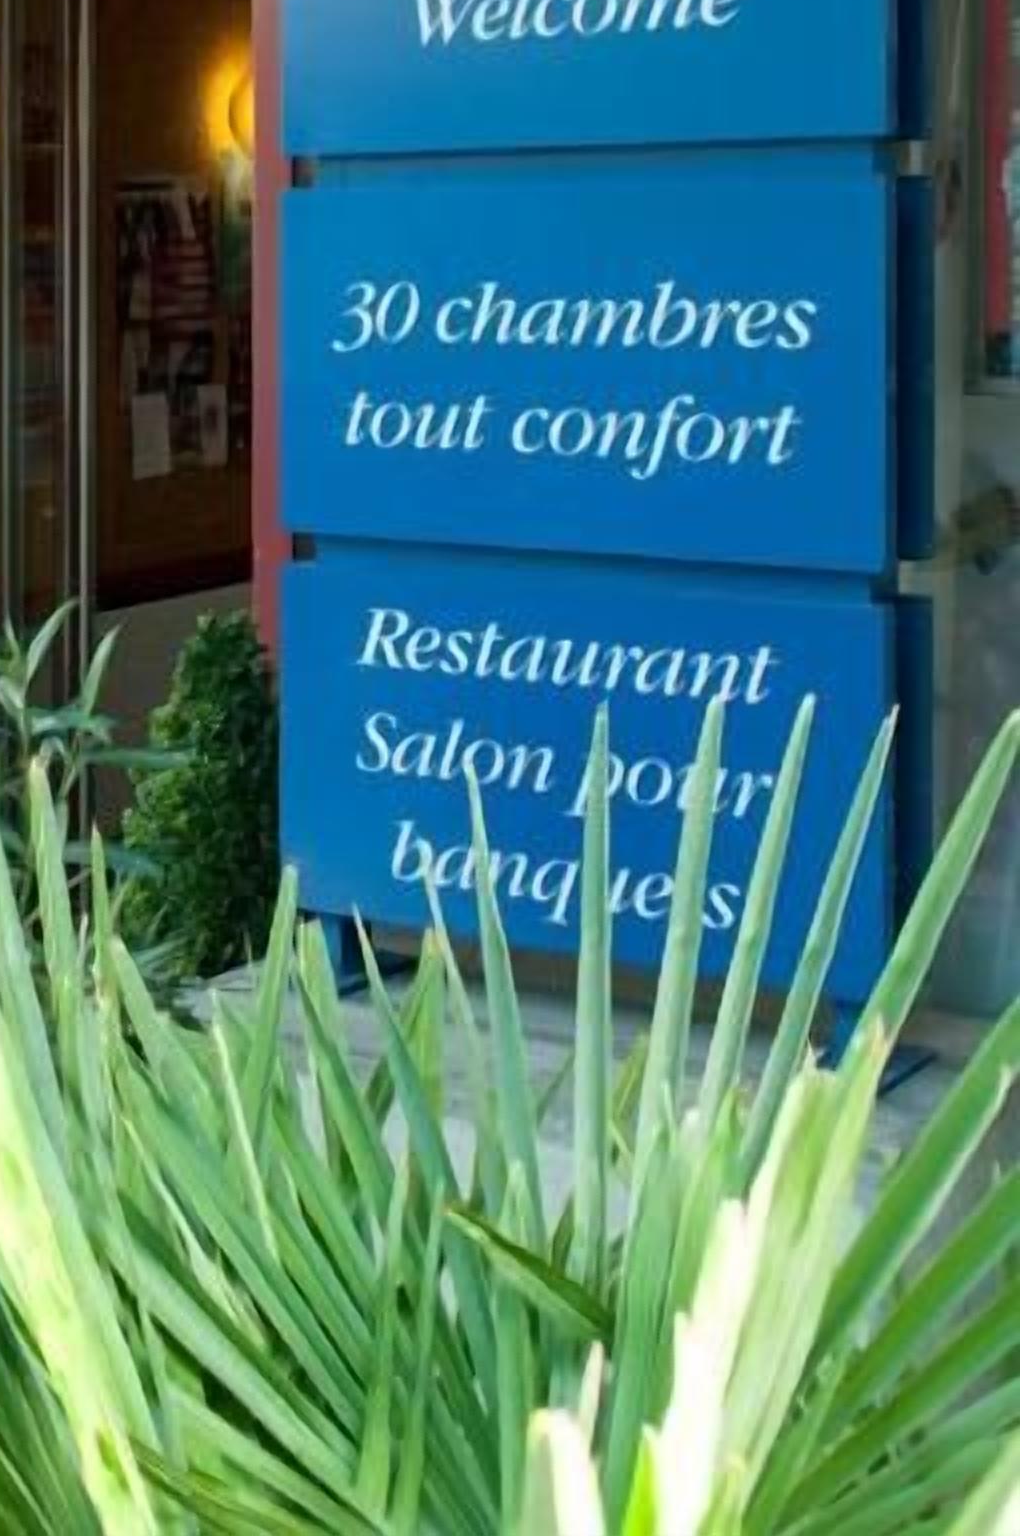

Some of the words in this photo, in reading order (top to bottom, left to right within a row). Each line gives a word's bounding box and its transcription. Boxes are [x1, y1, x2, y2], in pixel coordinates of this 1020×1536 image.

[332, 280, 420, 353] 30
[435, 280, 817, 350] chambres
[344, 390, 491, 449] tout
[511, 394, 802, 479] confort
[357, 607, 779, 704] Restaurant
[356, 711, 554, 793] Salon
